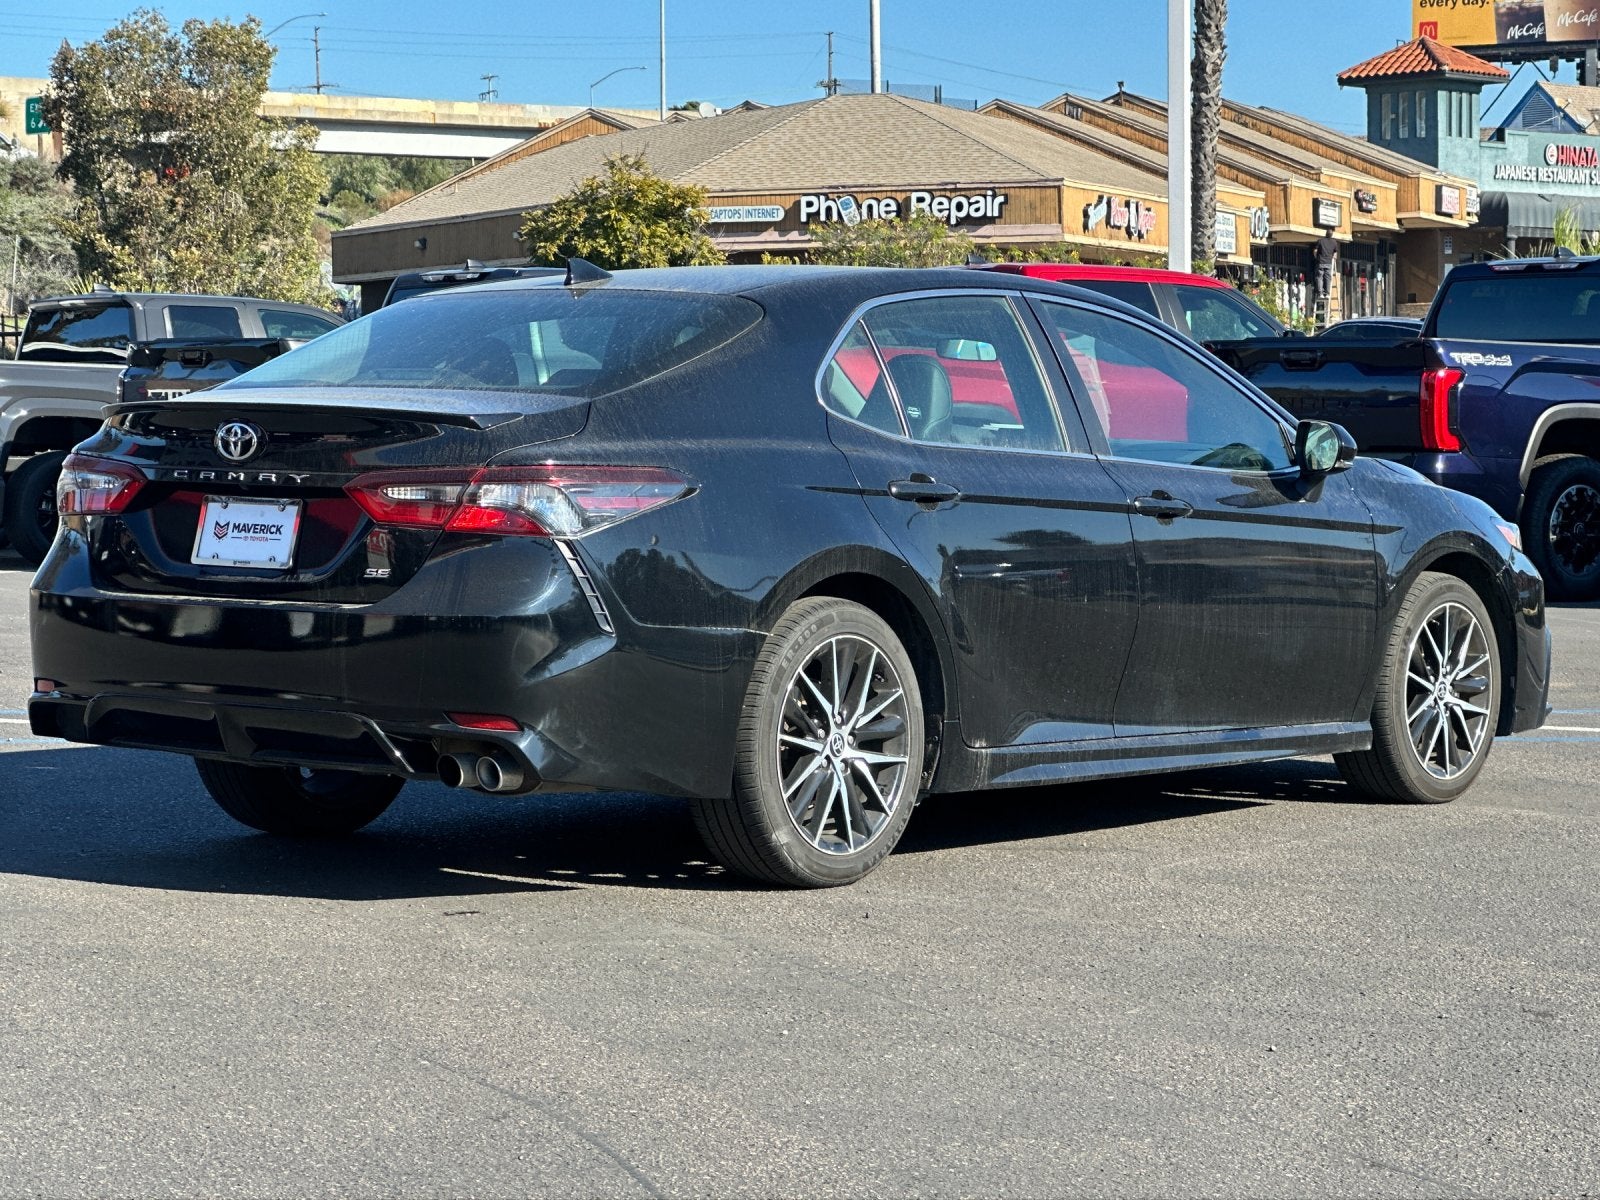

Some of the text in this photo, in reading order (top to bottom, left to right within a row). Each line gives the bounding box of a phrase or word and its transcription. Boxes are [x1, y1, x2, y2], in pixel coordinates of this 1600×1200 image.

[1557, 145, 1599, 168] HINATA
[1495, 165, 1538, 181] JAPANESE
[1538, 167, 1590, 184] RESTAURANT
[745, 207, 780, 219] INTERNET
[910, 190, 1005, 225] Repair
[174, 469, 310, 483] CAMRY
[231, 522, 284, 536] MAVERICK
[363, 568, 391, 578] SE
